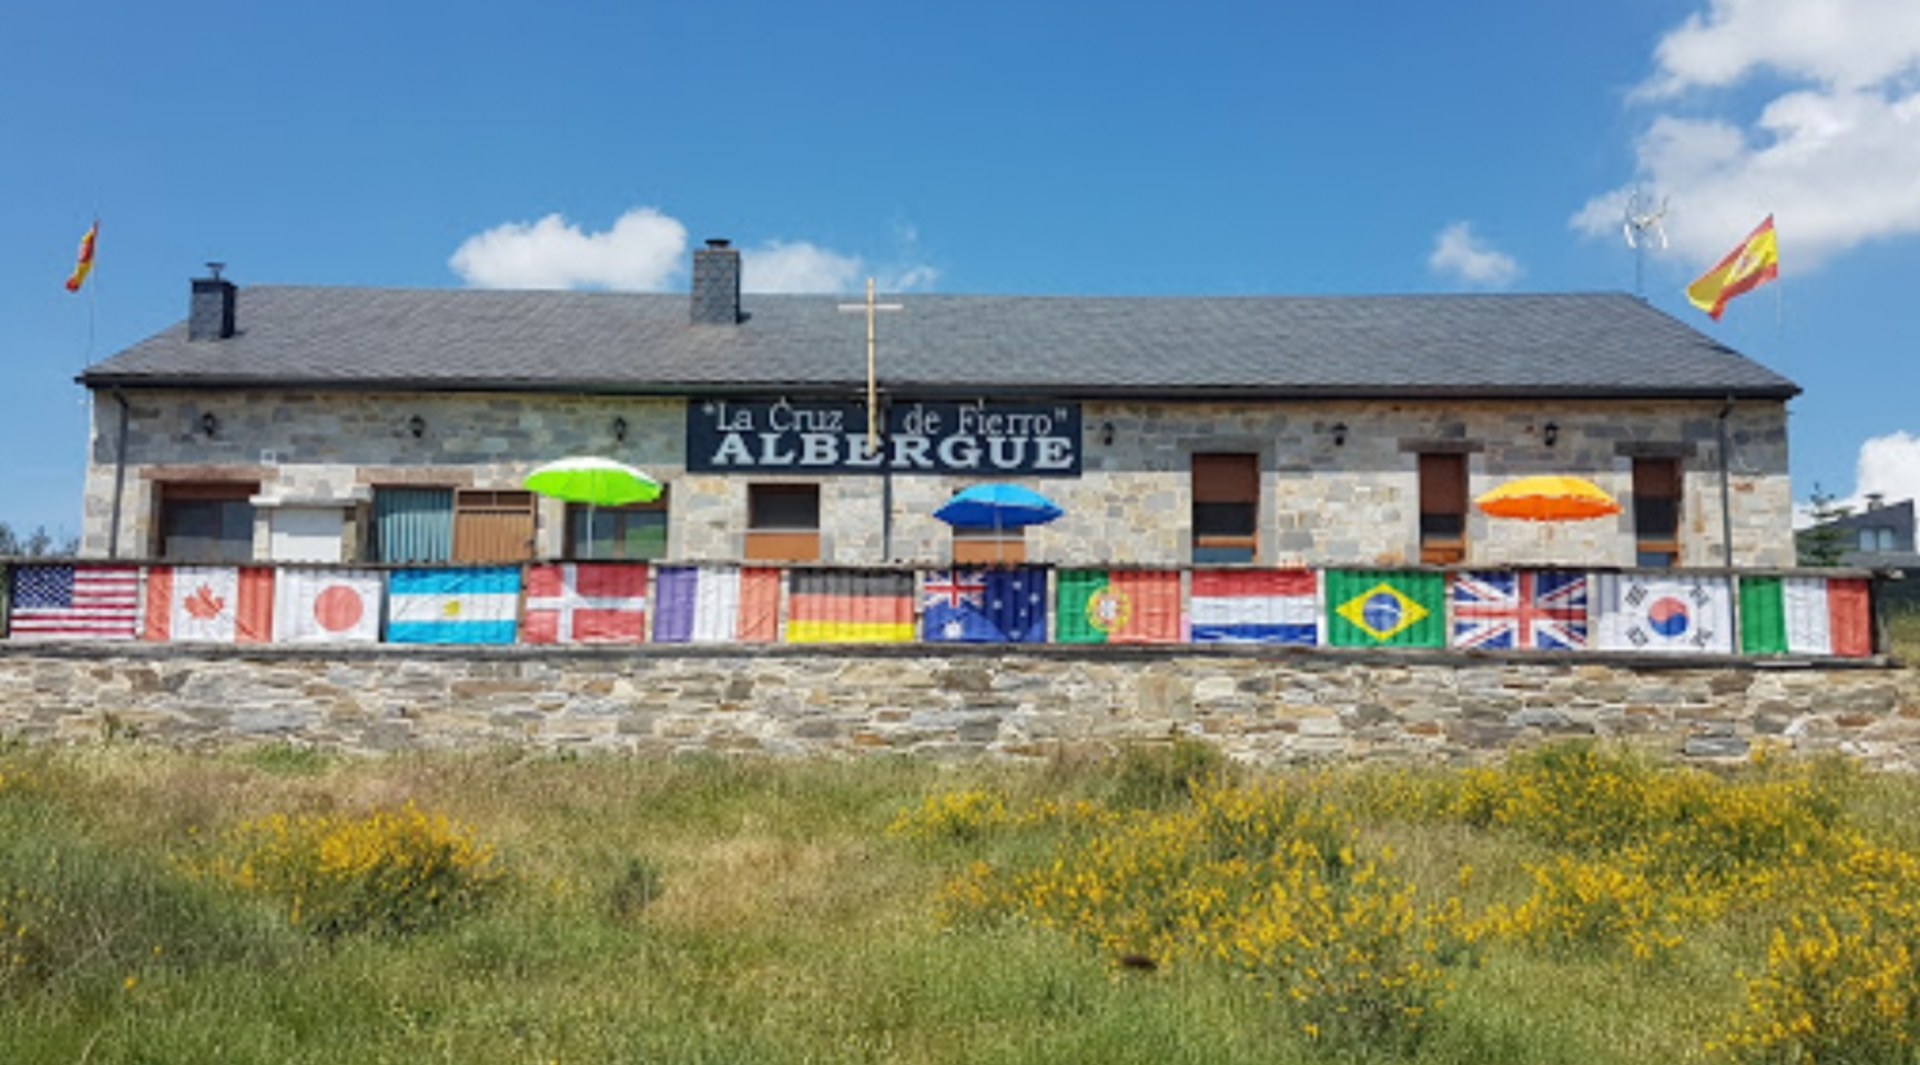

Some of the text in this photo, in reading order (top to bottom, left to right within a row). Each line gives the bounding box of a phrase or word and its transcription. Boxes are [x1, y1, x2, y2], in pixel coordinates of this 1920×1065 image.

[769, 398, 843, 431] Cruz
[903, 403, 941, 435] de
[711, 432, 1074, 469] ALBERGUE
